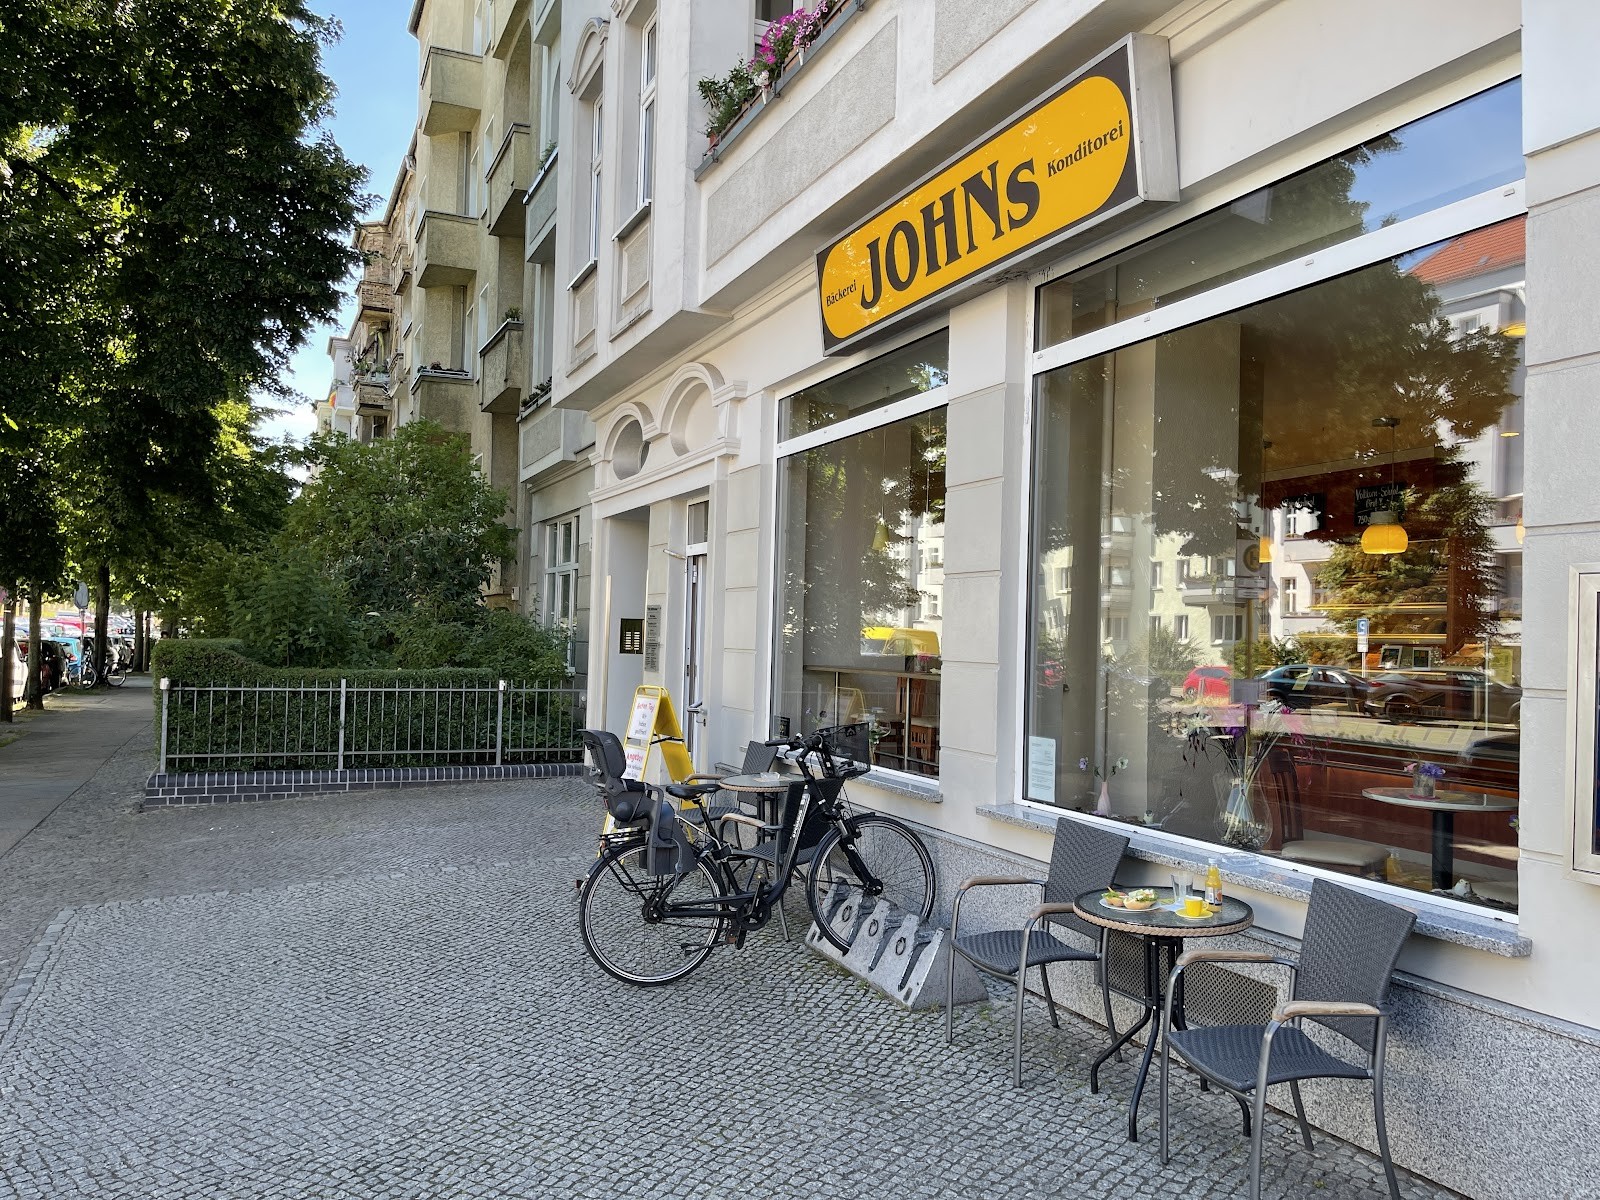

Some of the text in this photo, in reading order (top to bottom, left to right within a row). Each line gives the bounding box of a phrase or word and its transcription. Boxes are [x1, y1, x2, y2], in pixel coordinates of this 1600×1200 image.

[825, 120, 1125, 310] Bäckerei JOHNS Konditorei
